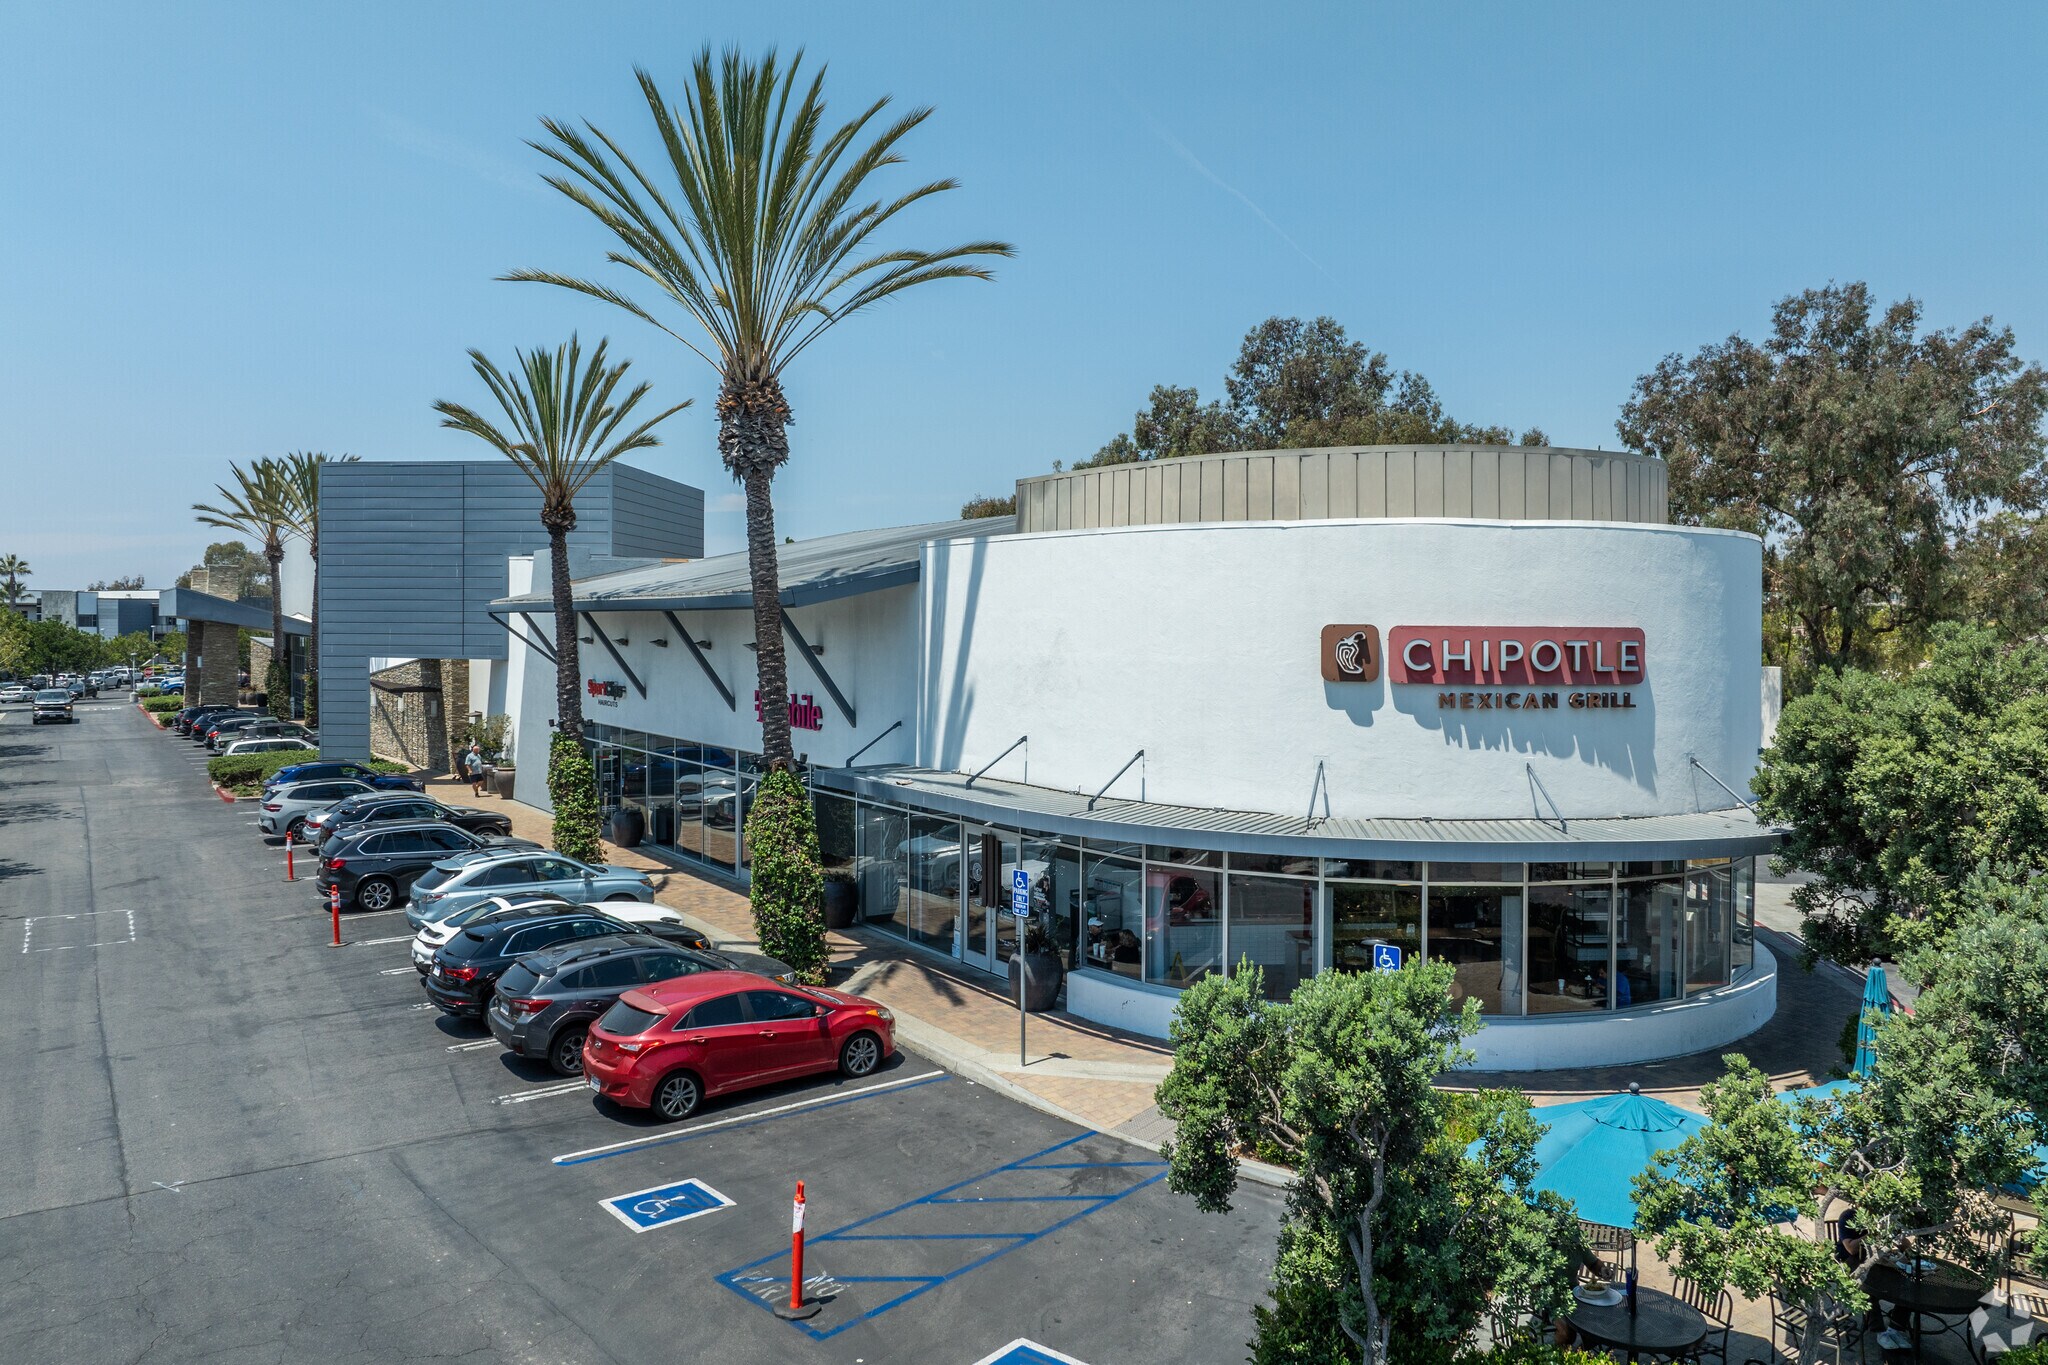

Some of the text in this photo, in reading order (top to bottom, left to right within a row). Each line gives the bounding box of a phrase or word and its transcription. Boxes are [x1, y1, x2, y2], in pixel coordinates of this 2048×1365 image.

[1402, 638, 1640, 672] CHIPOTLE
[1438, 692, 1637, 709] MEXICAN GRILL
